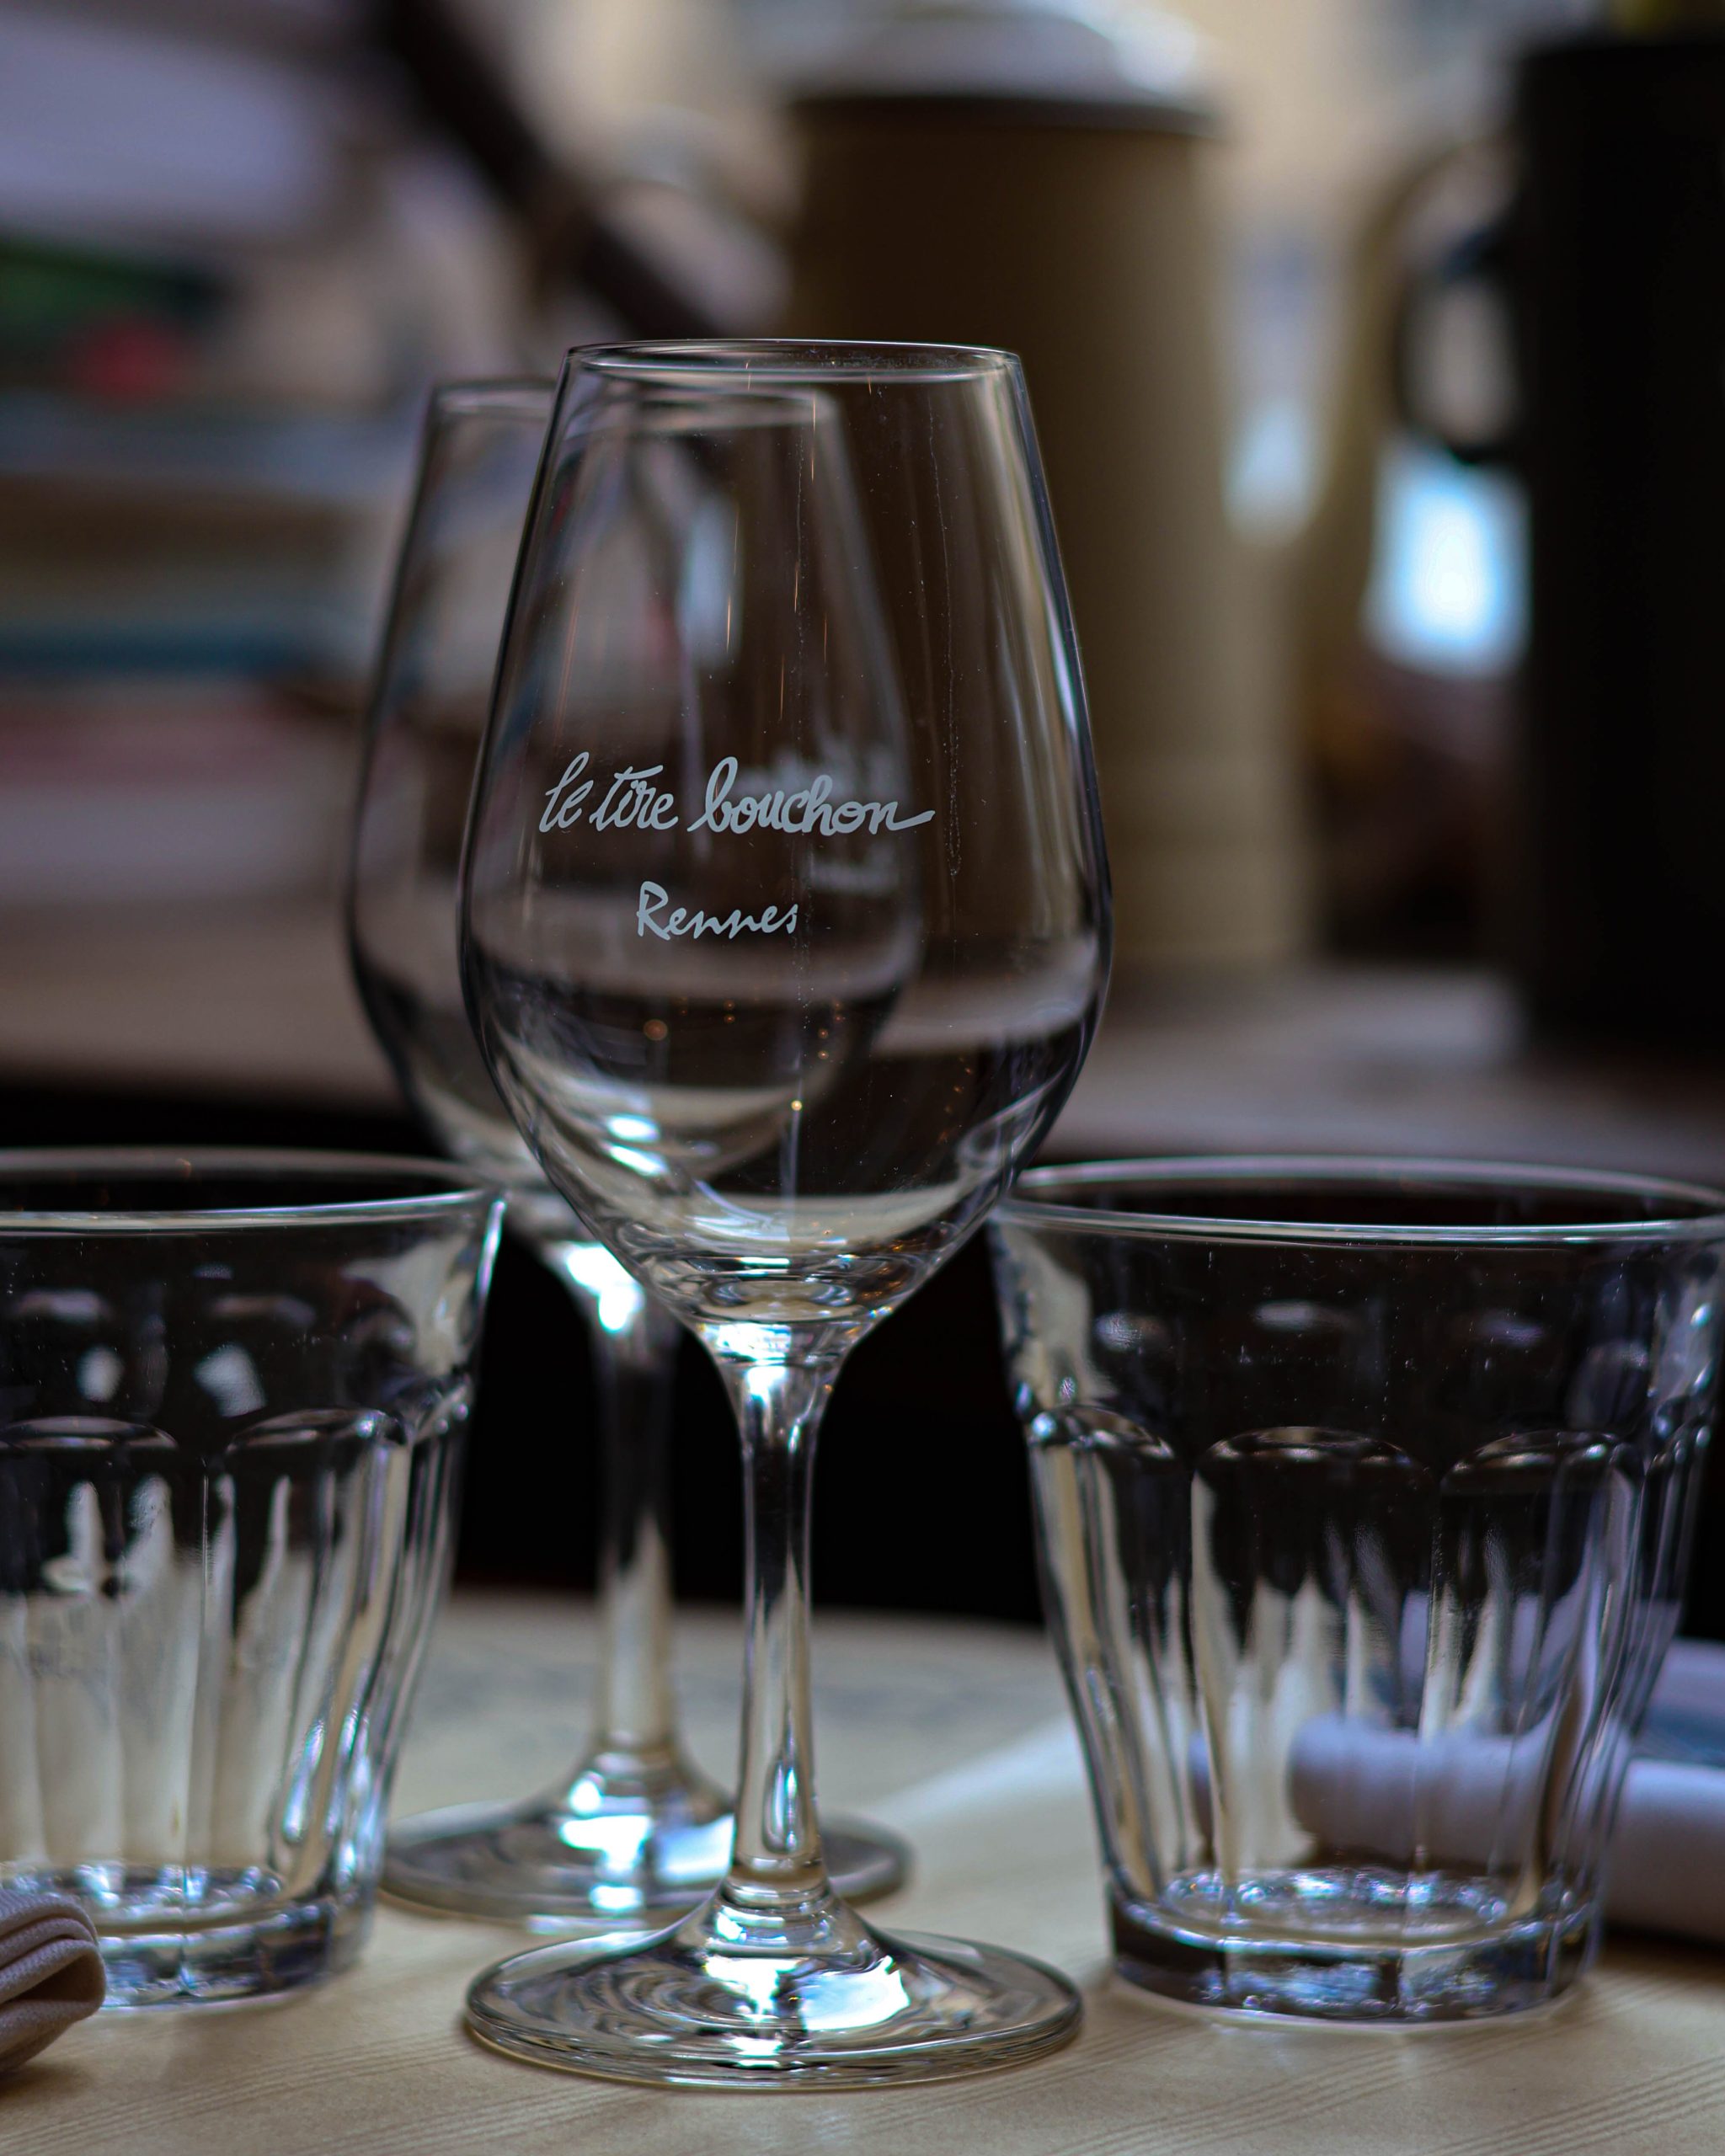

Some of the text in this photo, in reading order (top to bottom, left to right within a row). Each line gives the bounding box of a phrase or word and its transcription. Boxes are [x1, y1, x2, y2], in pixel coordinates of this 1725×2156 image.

[538, 751, 936, 836] le tire bouchon
[636, 881, 798, 941] Rennes
